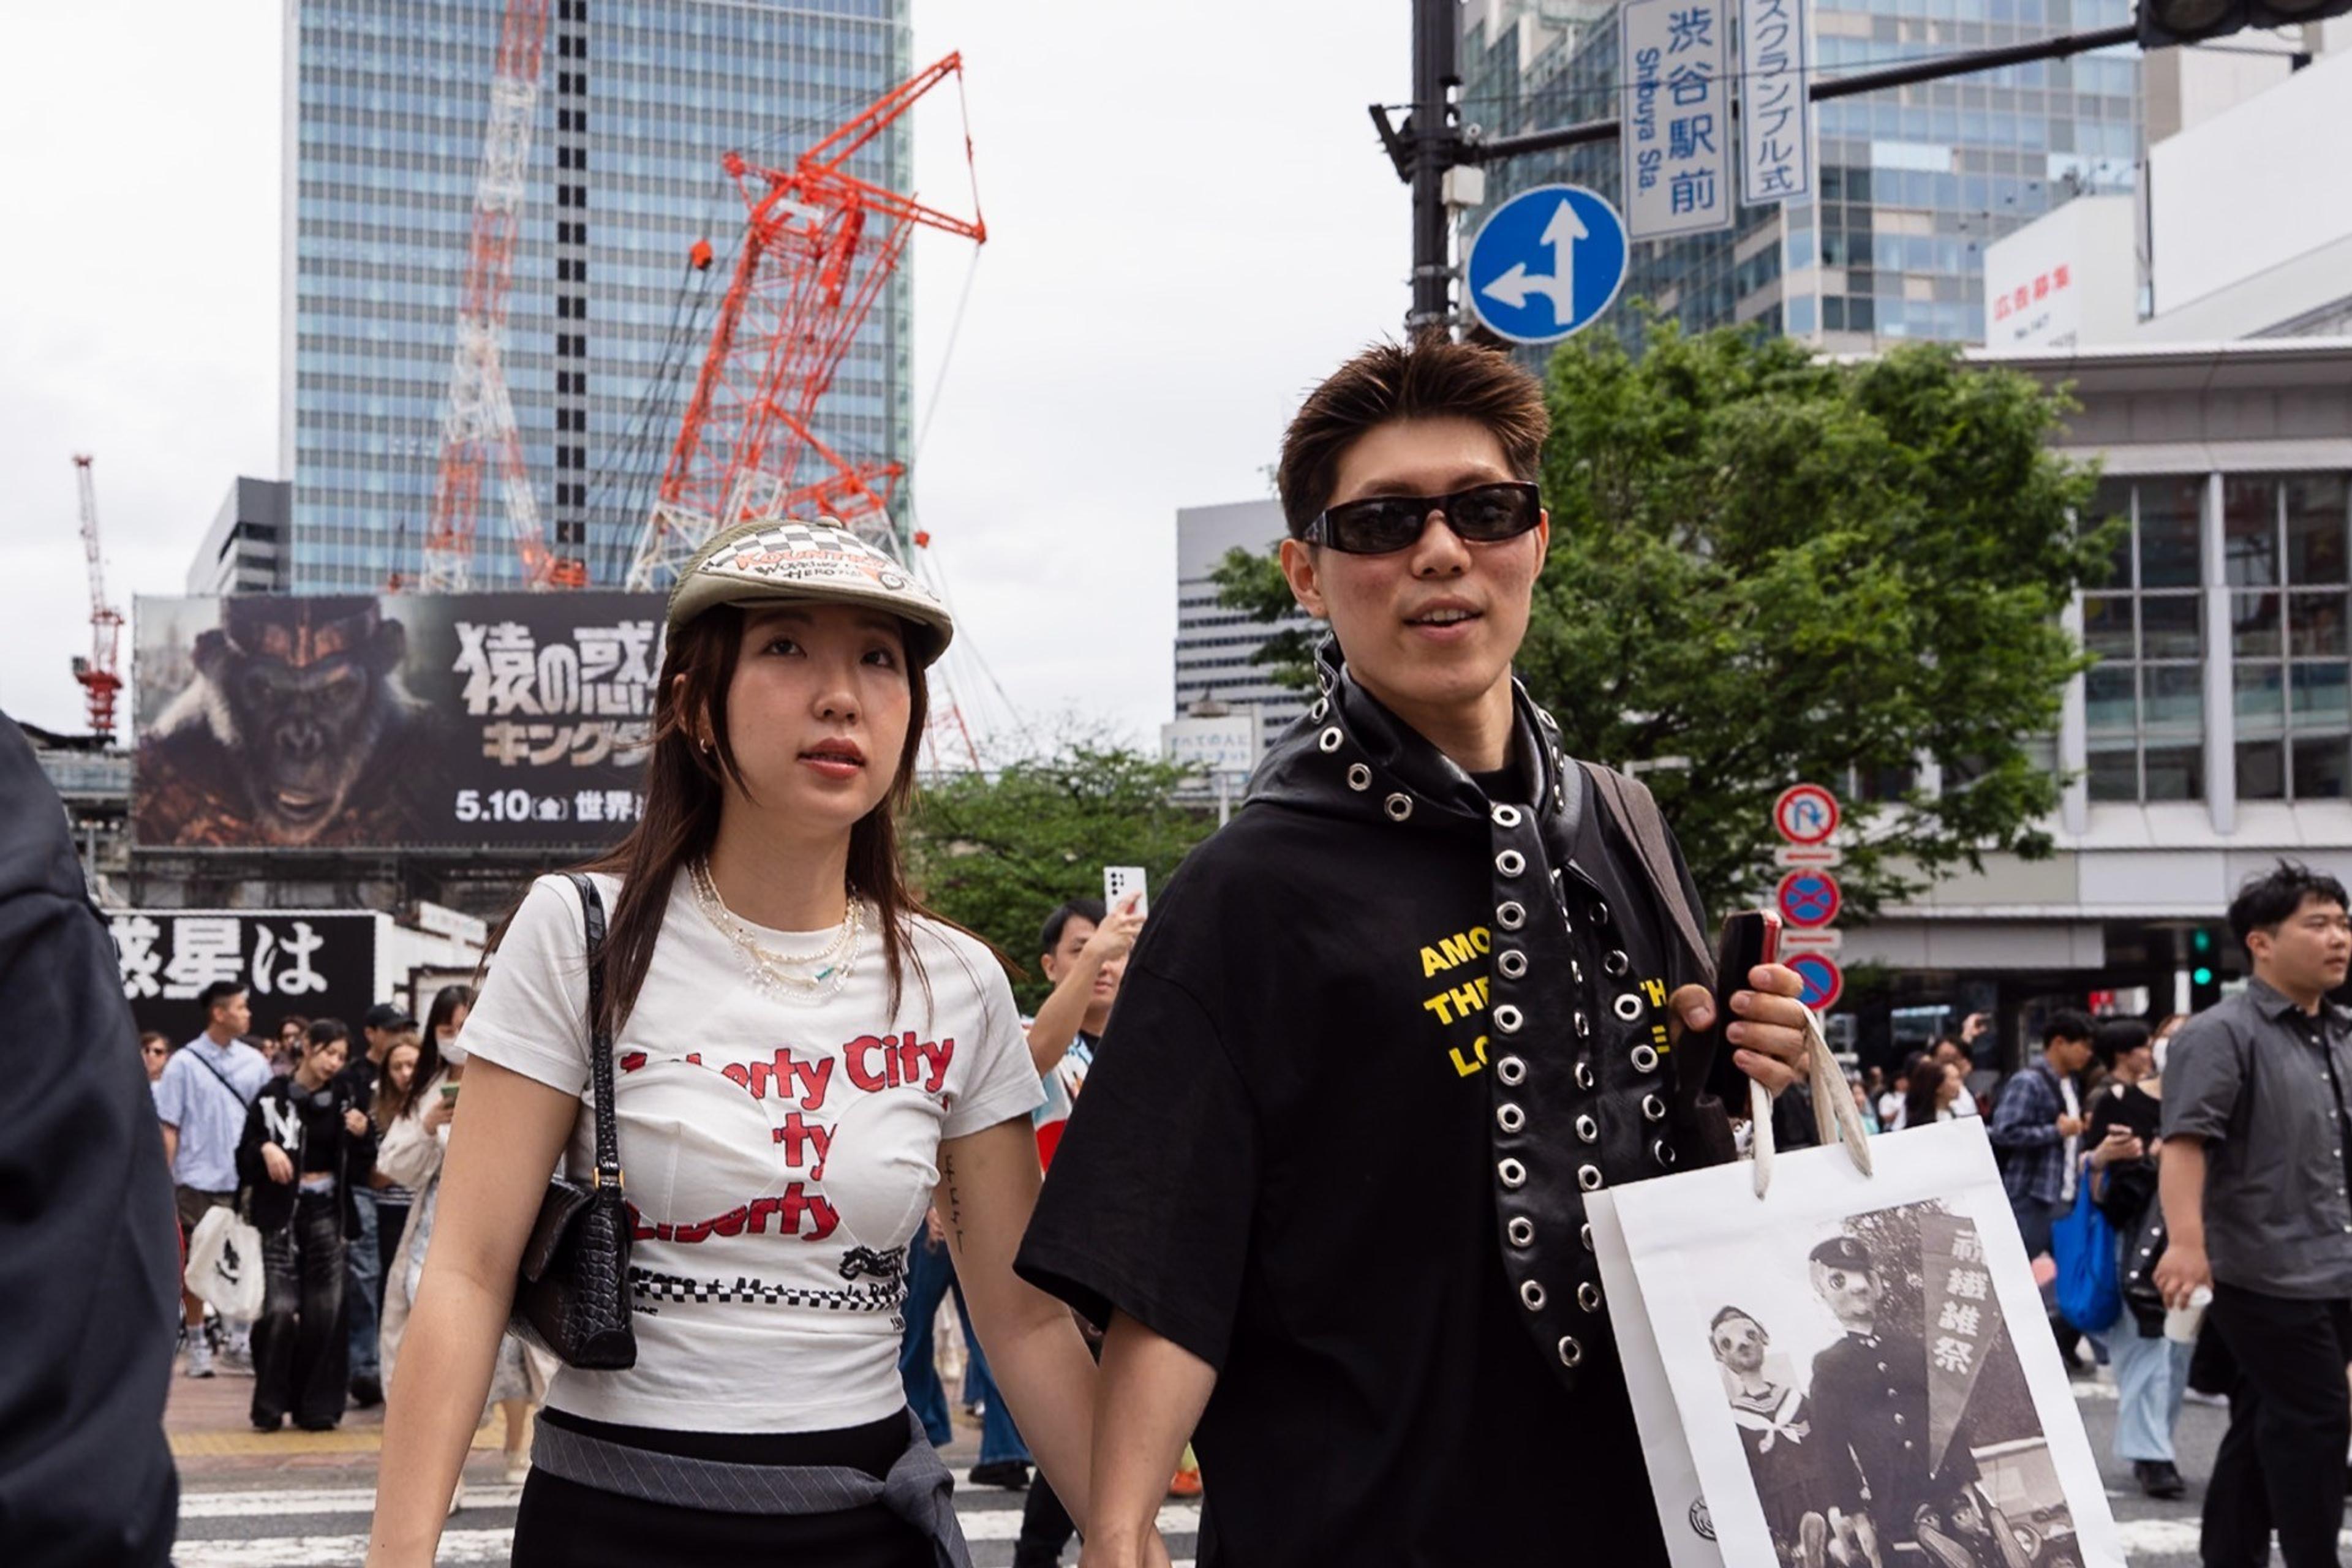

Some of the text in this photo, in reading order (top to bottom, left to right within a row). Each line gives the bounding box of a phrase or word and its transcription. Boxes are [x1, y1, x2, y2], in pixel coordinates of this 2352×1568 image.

[1634, 47, 1662, 197] Shibuya Sta.
[1667, 6, 1716, 216] 渋谷駅前
[1755, 0, 1793, 194] スクランブル式
[843, 1031, 954, 1092] City
